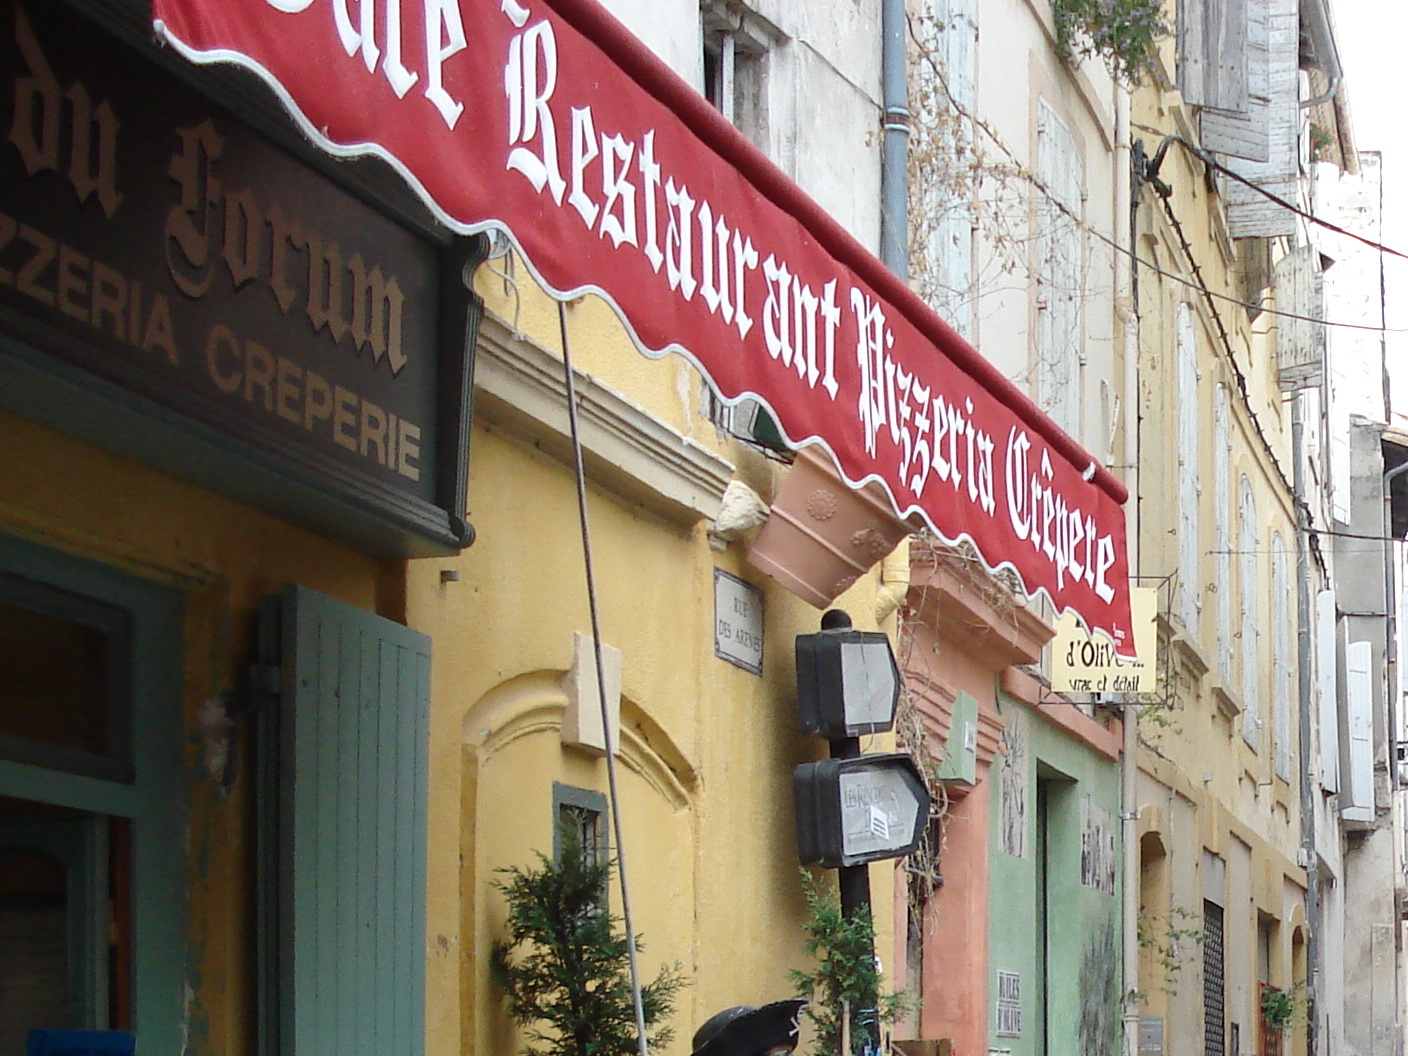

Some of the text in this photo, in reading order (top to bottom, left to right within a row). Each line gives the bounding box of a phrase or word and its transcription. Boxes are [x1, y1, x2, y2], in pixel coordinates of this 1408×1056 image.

[164, 117, 408, 377] Forum
[208, 324, 422, 482] CREPERIE
[850, 286, 996, 517] Pizzeria
[718, 618, 732, 640] DES
[733, 597, 750, 619] RUE
